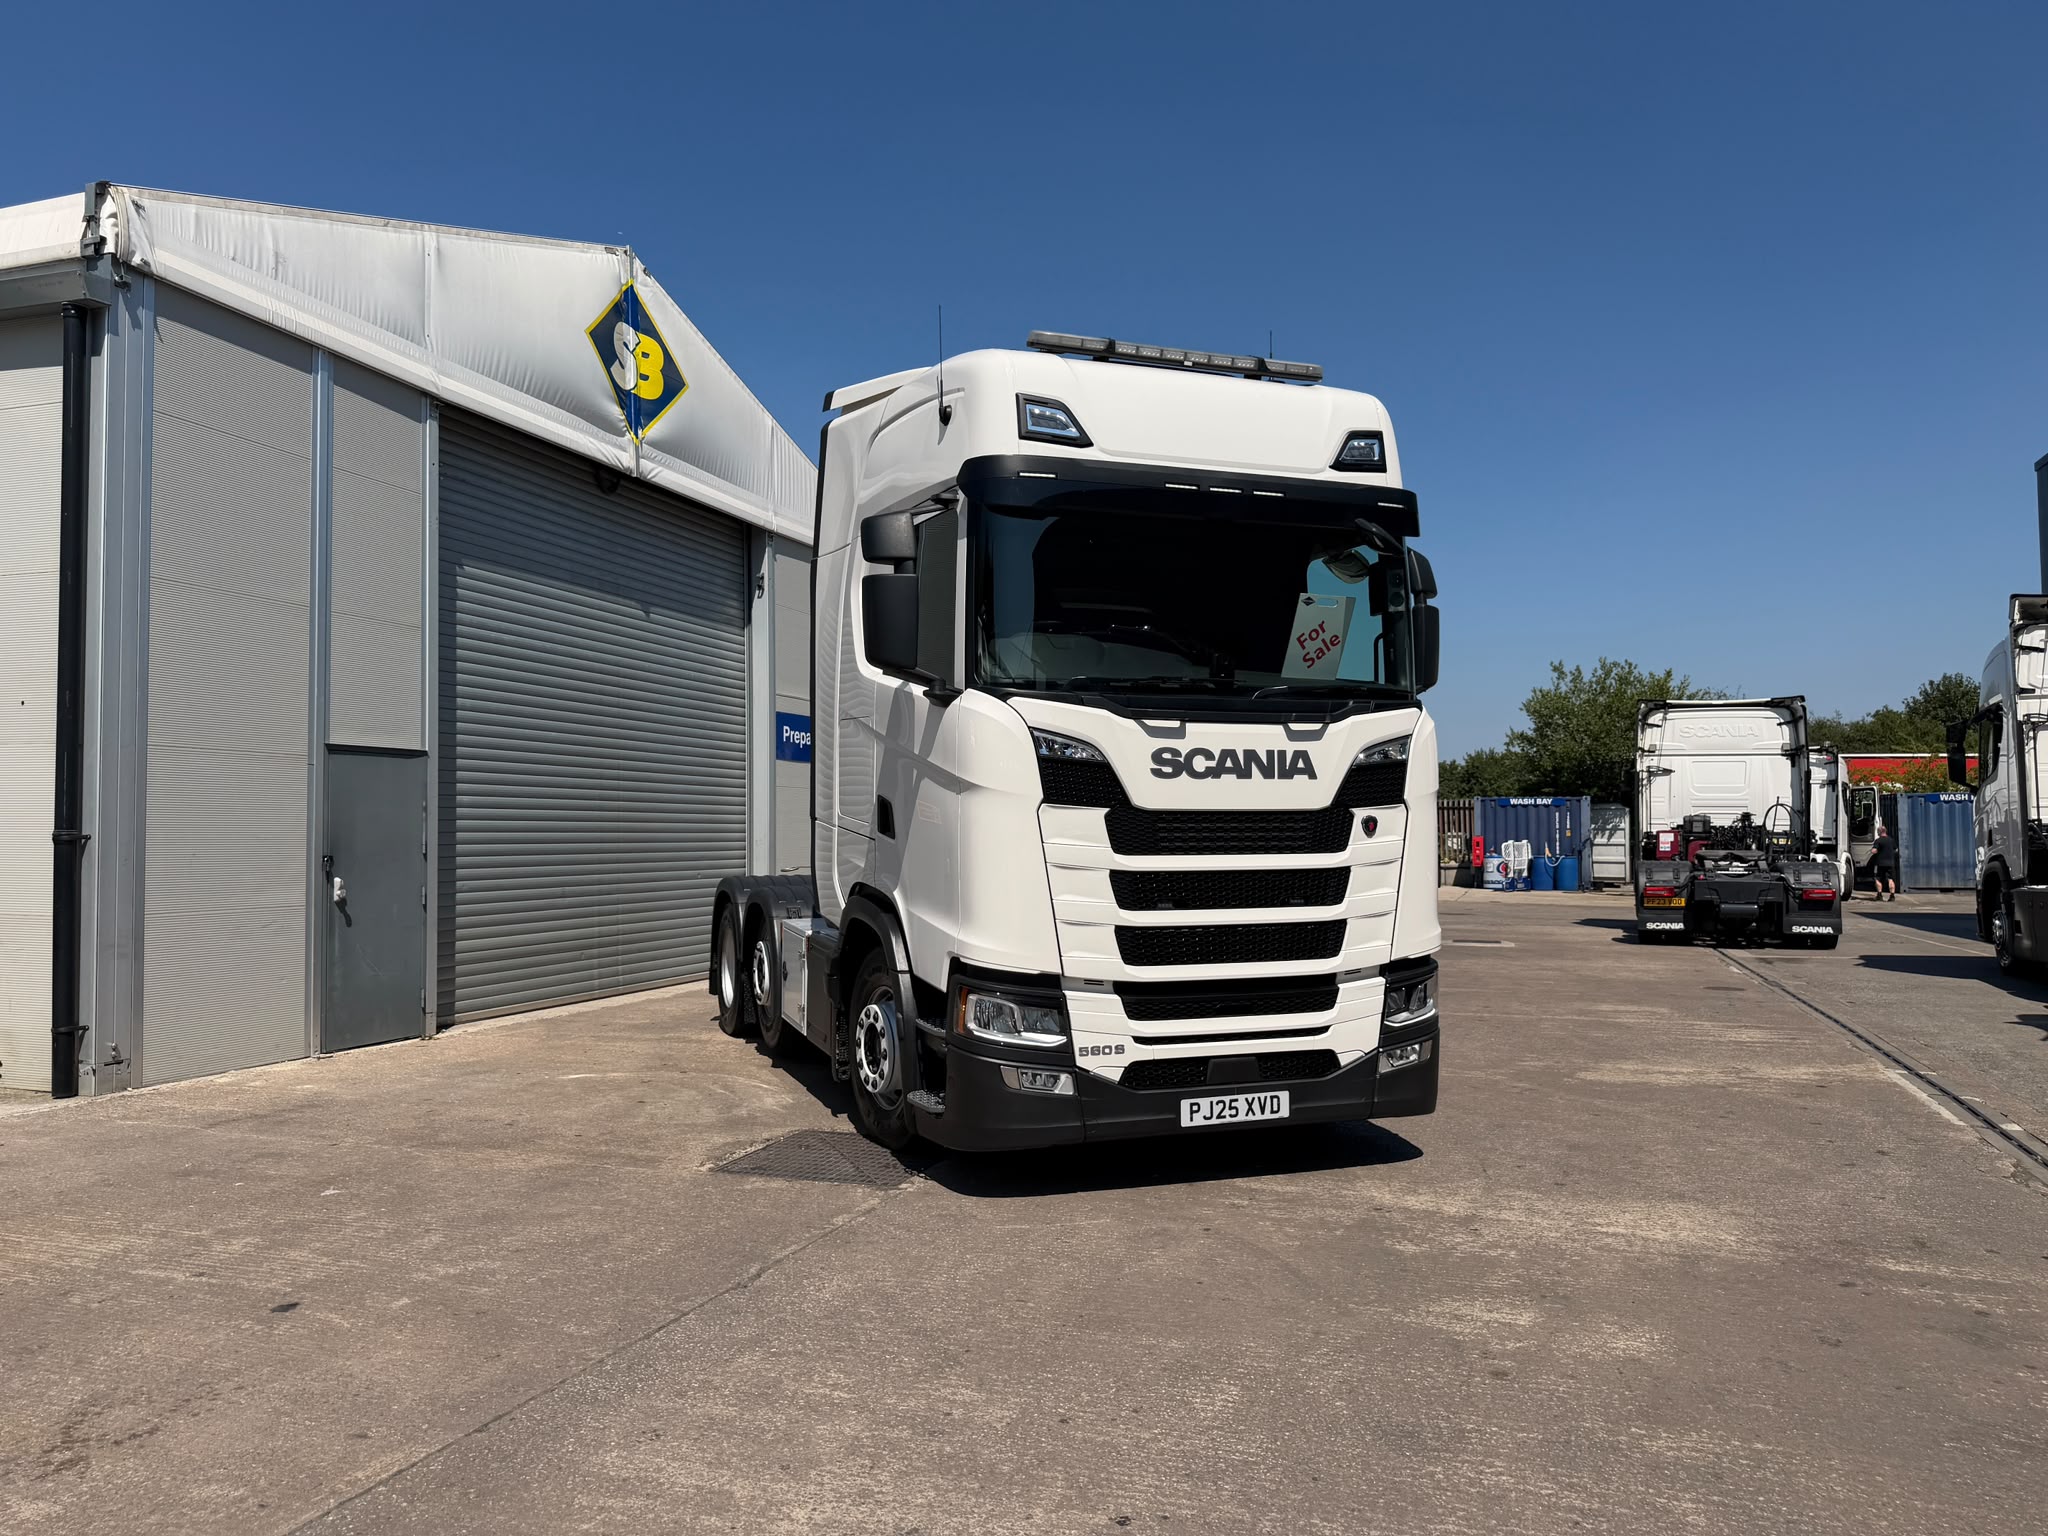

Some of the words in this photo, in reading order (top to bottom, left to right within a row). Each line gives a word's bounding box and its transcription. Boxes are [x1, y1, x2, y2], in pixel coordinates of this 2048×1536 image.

[610, 321, 665, 400] SB
[1296, 620, 1326, 651] For
[1302, 634, 1341, 669] Sale
[783, 725, 811, 748] Prepa
[1679, 722, 1760, 738] SCANIA
[1150, 746, 1318, 780] SCANIA
[1940, 793, 1969, 801] WASH
[1646, 922, 1685, 930] SCANIA
[1792, 925, 1834, 934] SCANIA
[1079, 1044, 1126, 1057] 560S
[1189, 1098, 1239, 1122] PJ25
[1244, 1094, 1281, 1117] XVD
